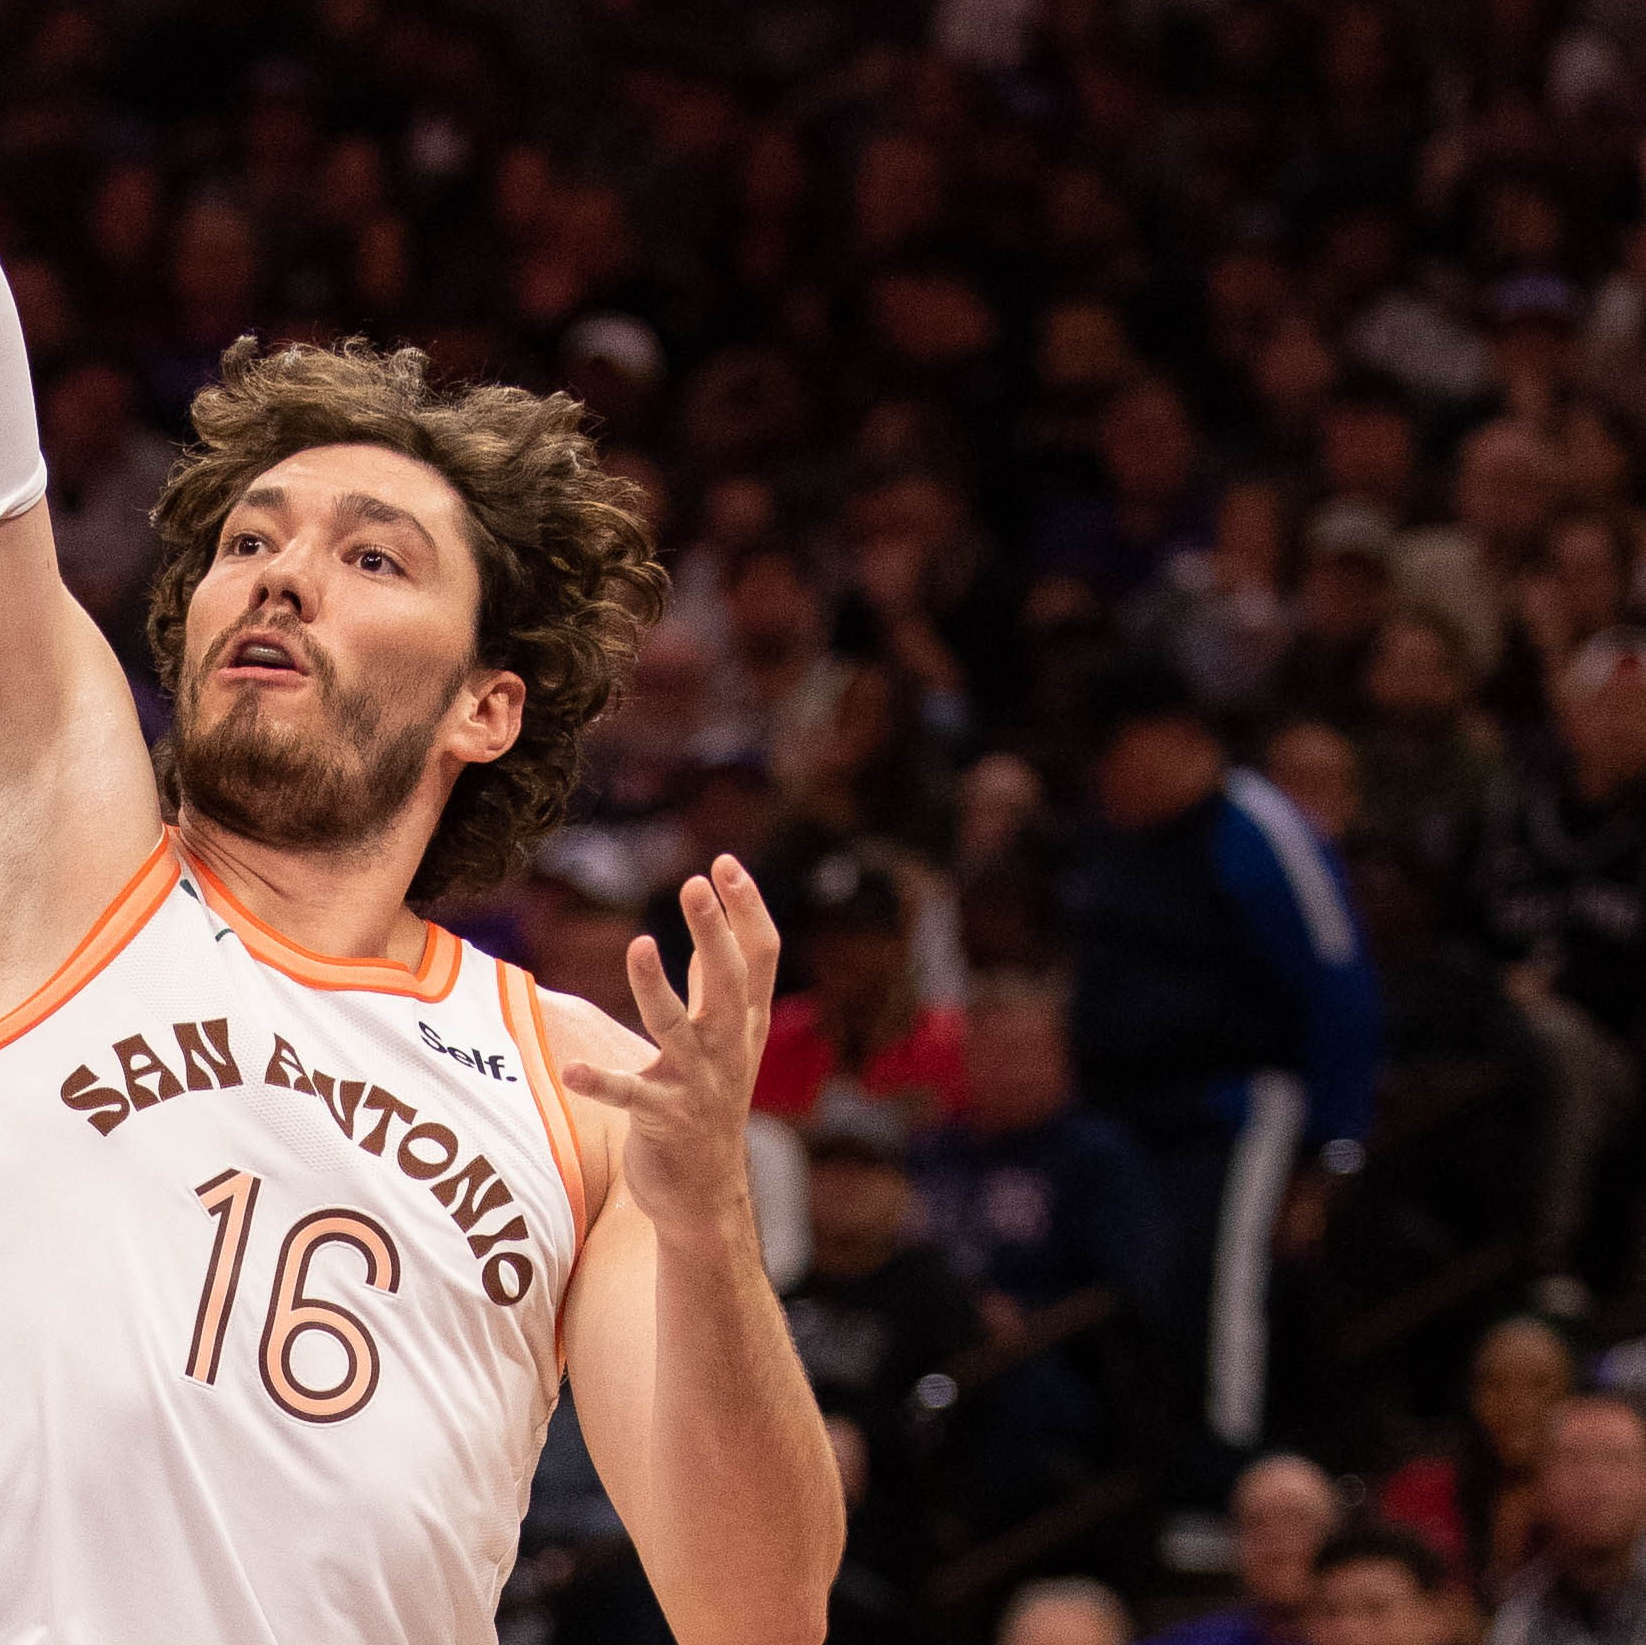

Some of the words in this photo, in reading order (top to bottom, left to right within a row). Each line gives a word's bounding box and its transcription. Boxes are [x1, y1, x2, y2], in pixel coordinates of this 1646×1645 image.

[60, 1018, 243, 1137] SAN
[264, 1032, 533, 1307] ANTONIO
[418, 1021, 517, 1082] Self.
[185, 1166, 401, 1423] 16
